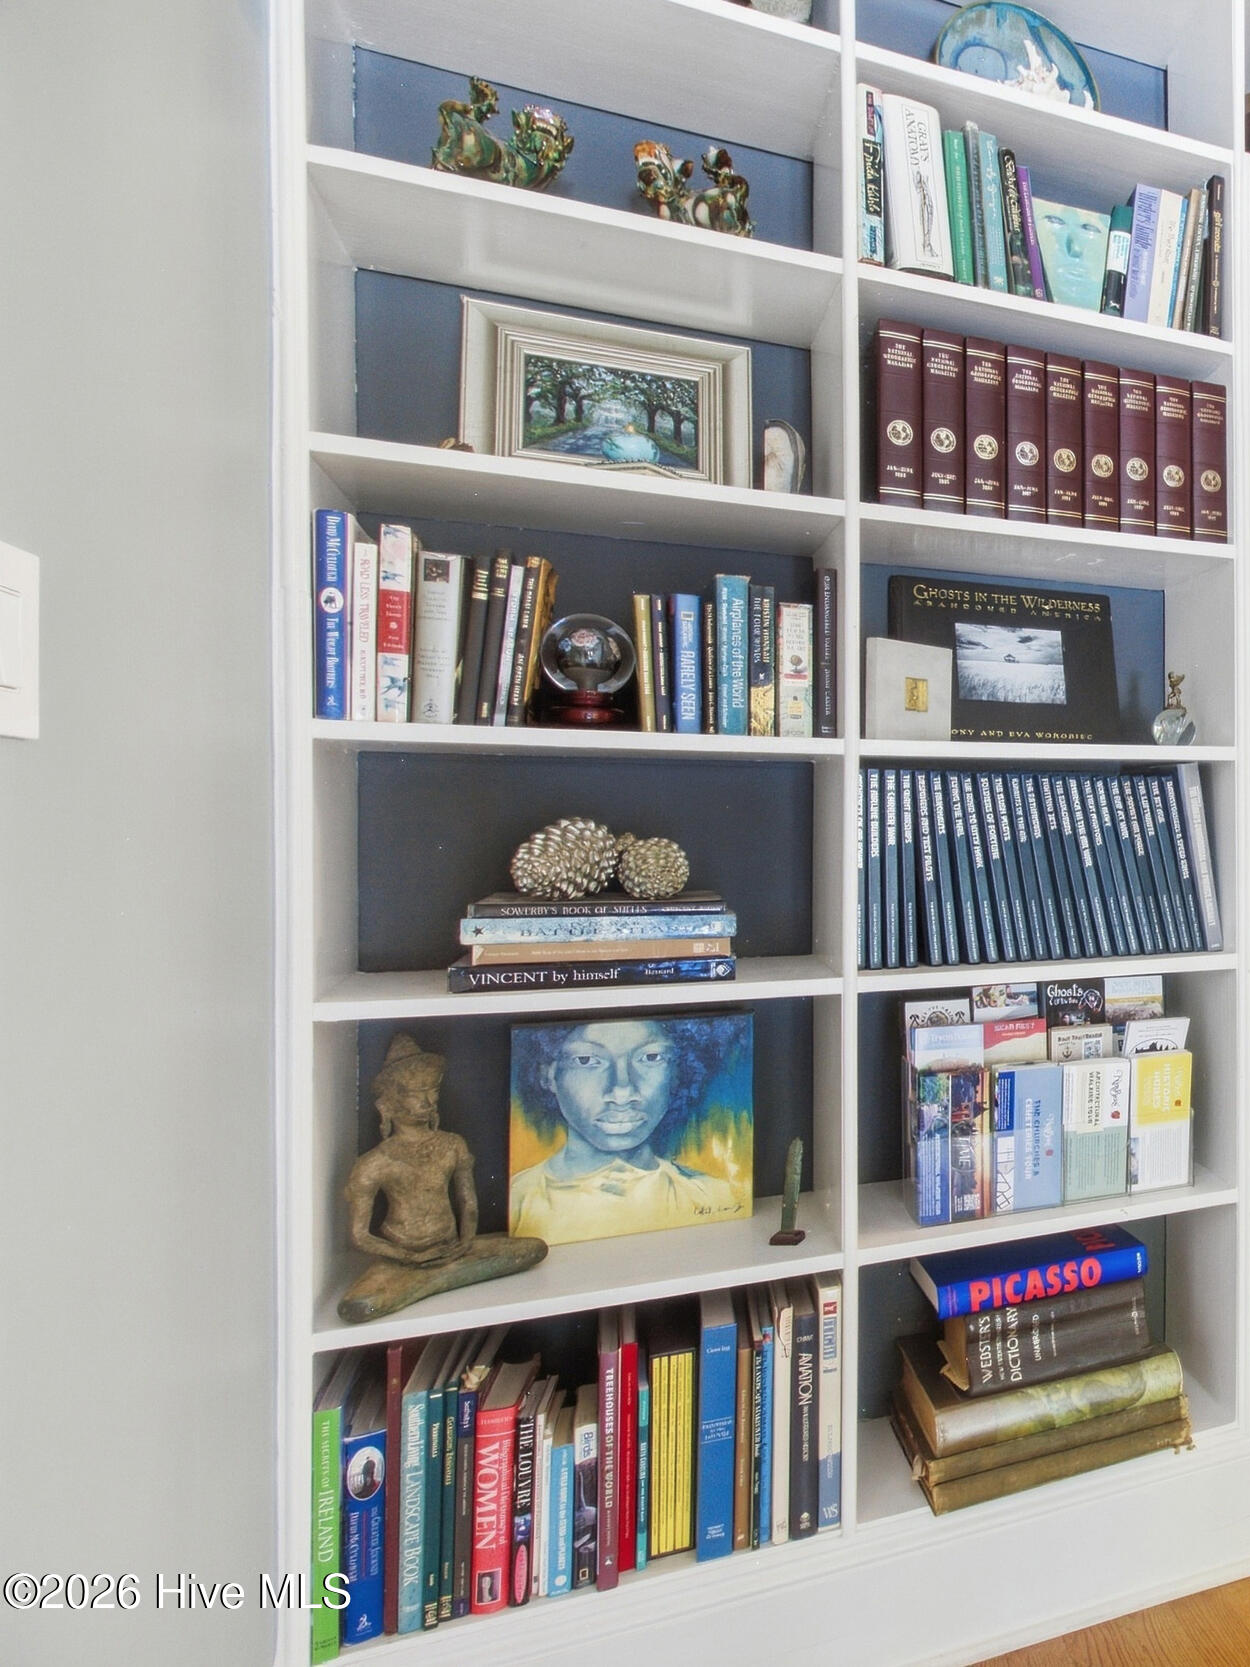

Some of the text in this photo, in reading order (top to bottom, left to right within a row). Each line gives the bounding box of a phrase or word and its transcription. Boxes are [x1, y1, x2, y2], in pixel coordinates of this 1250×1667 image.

[905, 109, 919, 168] ANATOMY
[975, 592, 987, 602] IN
[992, 594, 1017, 605] THE
[730, 598, 744, 650] Airplanes
[680, 650, 695, 691] RARELY
[732, 649, 743, 659] of
[732, 661, 743, 676] the
[681, 693, 695, 720] SEEN
[469, 967, 621, 985] VINCENT by himself
[1047, 984, 1083, 997] Ghosts
[969, 1257, 1102, 1312] PICASSO
[1006, 1307, 1023, 1382] DICTIONARY
[605, 1368, 614, 1435] TREEHOUSES
[798, 1353, 813, 1406] AVIATION
[517, 1421, 534, 1507] THE LOUVRE
[582, 1431, 594, 1458] Birds
[605, 1436, 614, 1449] OF
[605, 1451, 614, 1470] THE
[475, 1441, 500, 1550] WOMEN
[318, 1489, 334, 1562] IRELAND
[403, 1470, 422, 1587] LANDSCAPE BOOK
